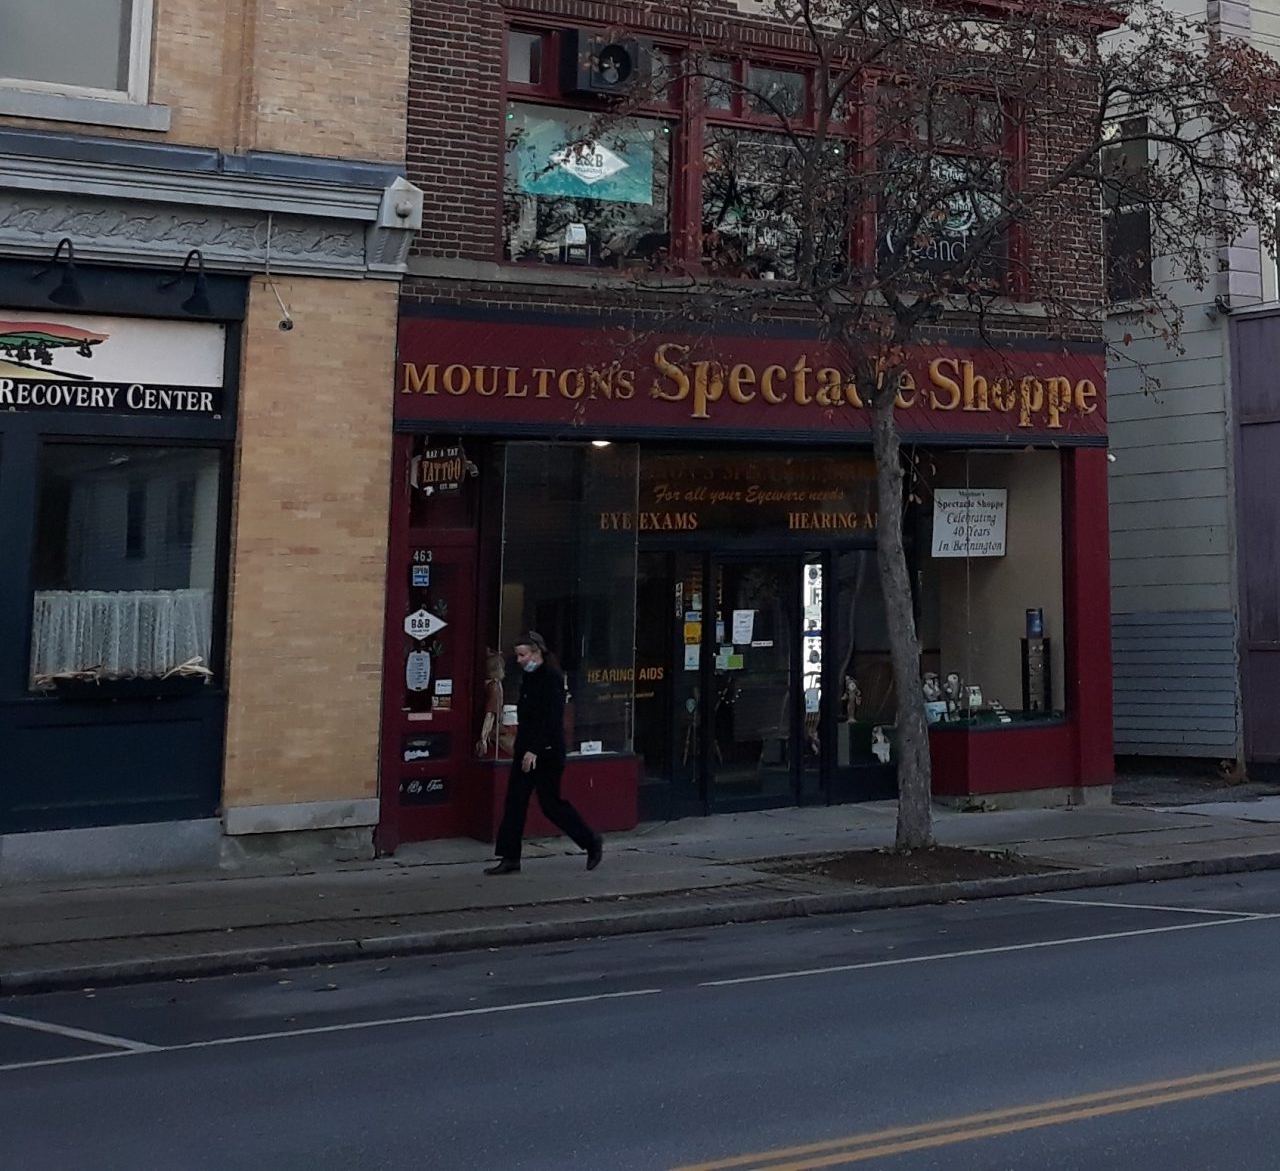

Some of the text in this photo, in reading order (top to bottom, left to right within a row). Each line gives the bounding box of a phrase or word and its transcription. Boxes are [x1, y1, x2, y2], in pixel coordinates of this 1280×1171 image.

[0, 378, 214, 412] RECOVERY CENTER
[929, 357, 1098, 428] Shoppe
[422, 457, 461, 483] TATTOO
[654, 485, 680, 504] For
[685, 486, 704, 501] all
[938, 499, 1004, 511] Spectacle Shoppe
[600, 511, 699, 531] EYE EXAMS
[788, 511, 858, 530] HEARING
[946, 513, 997, 527] Celebrating
[952, 525, 991, 537] 40 Years
[938, 539, 1002, 554] In Bennington
[413, 550, 432, 562] 463
[411, 618, 430, 628] B&B
[587, 667, 665, 683] HEARING AIDS
